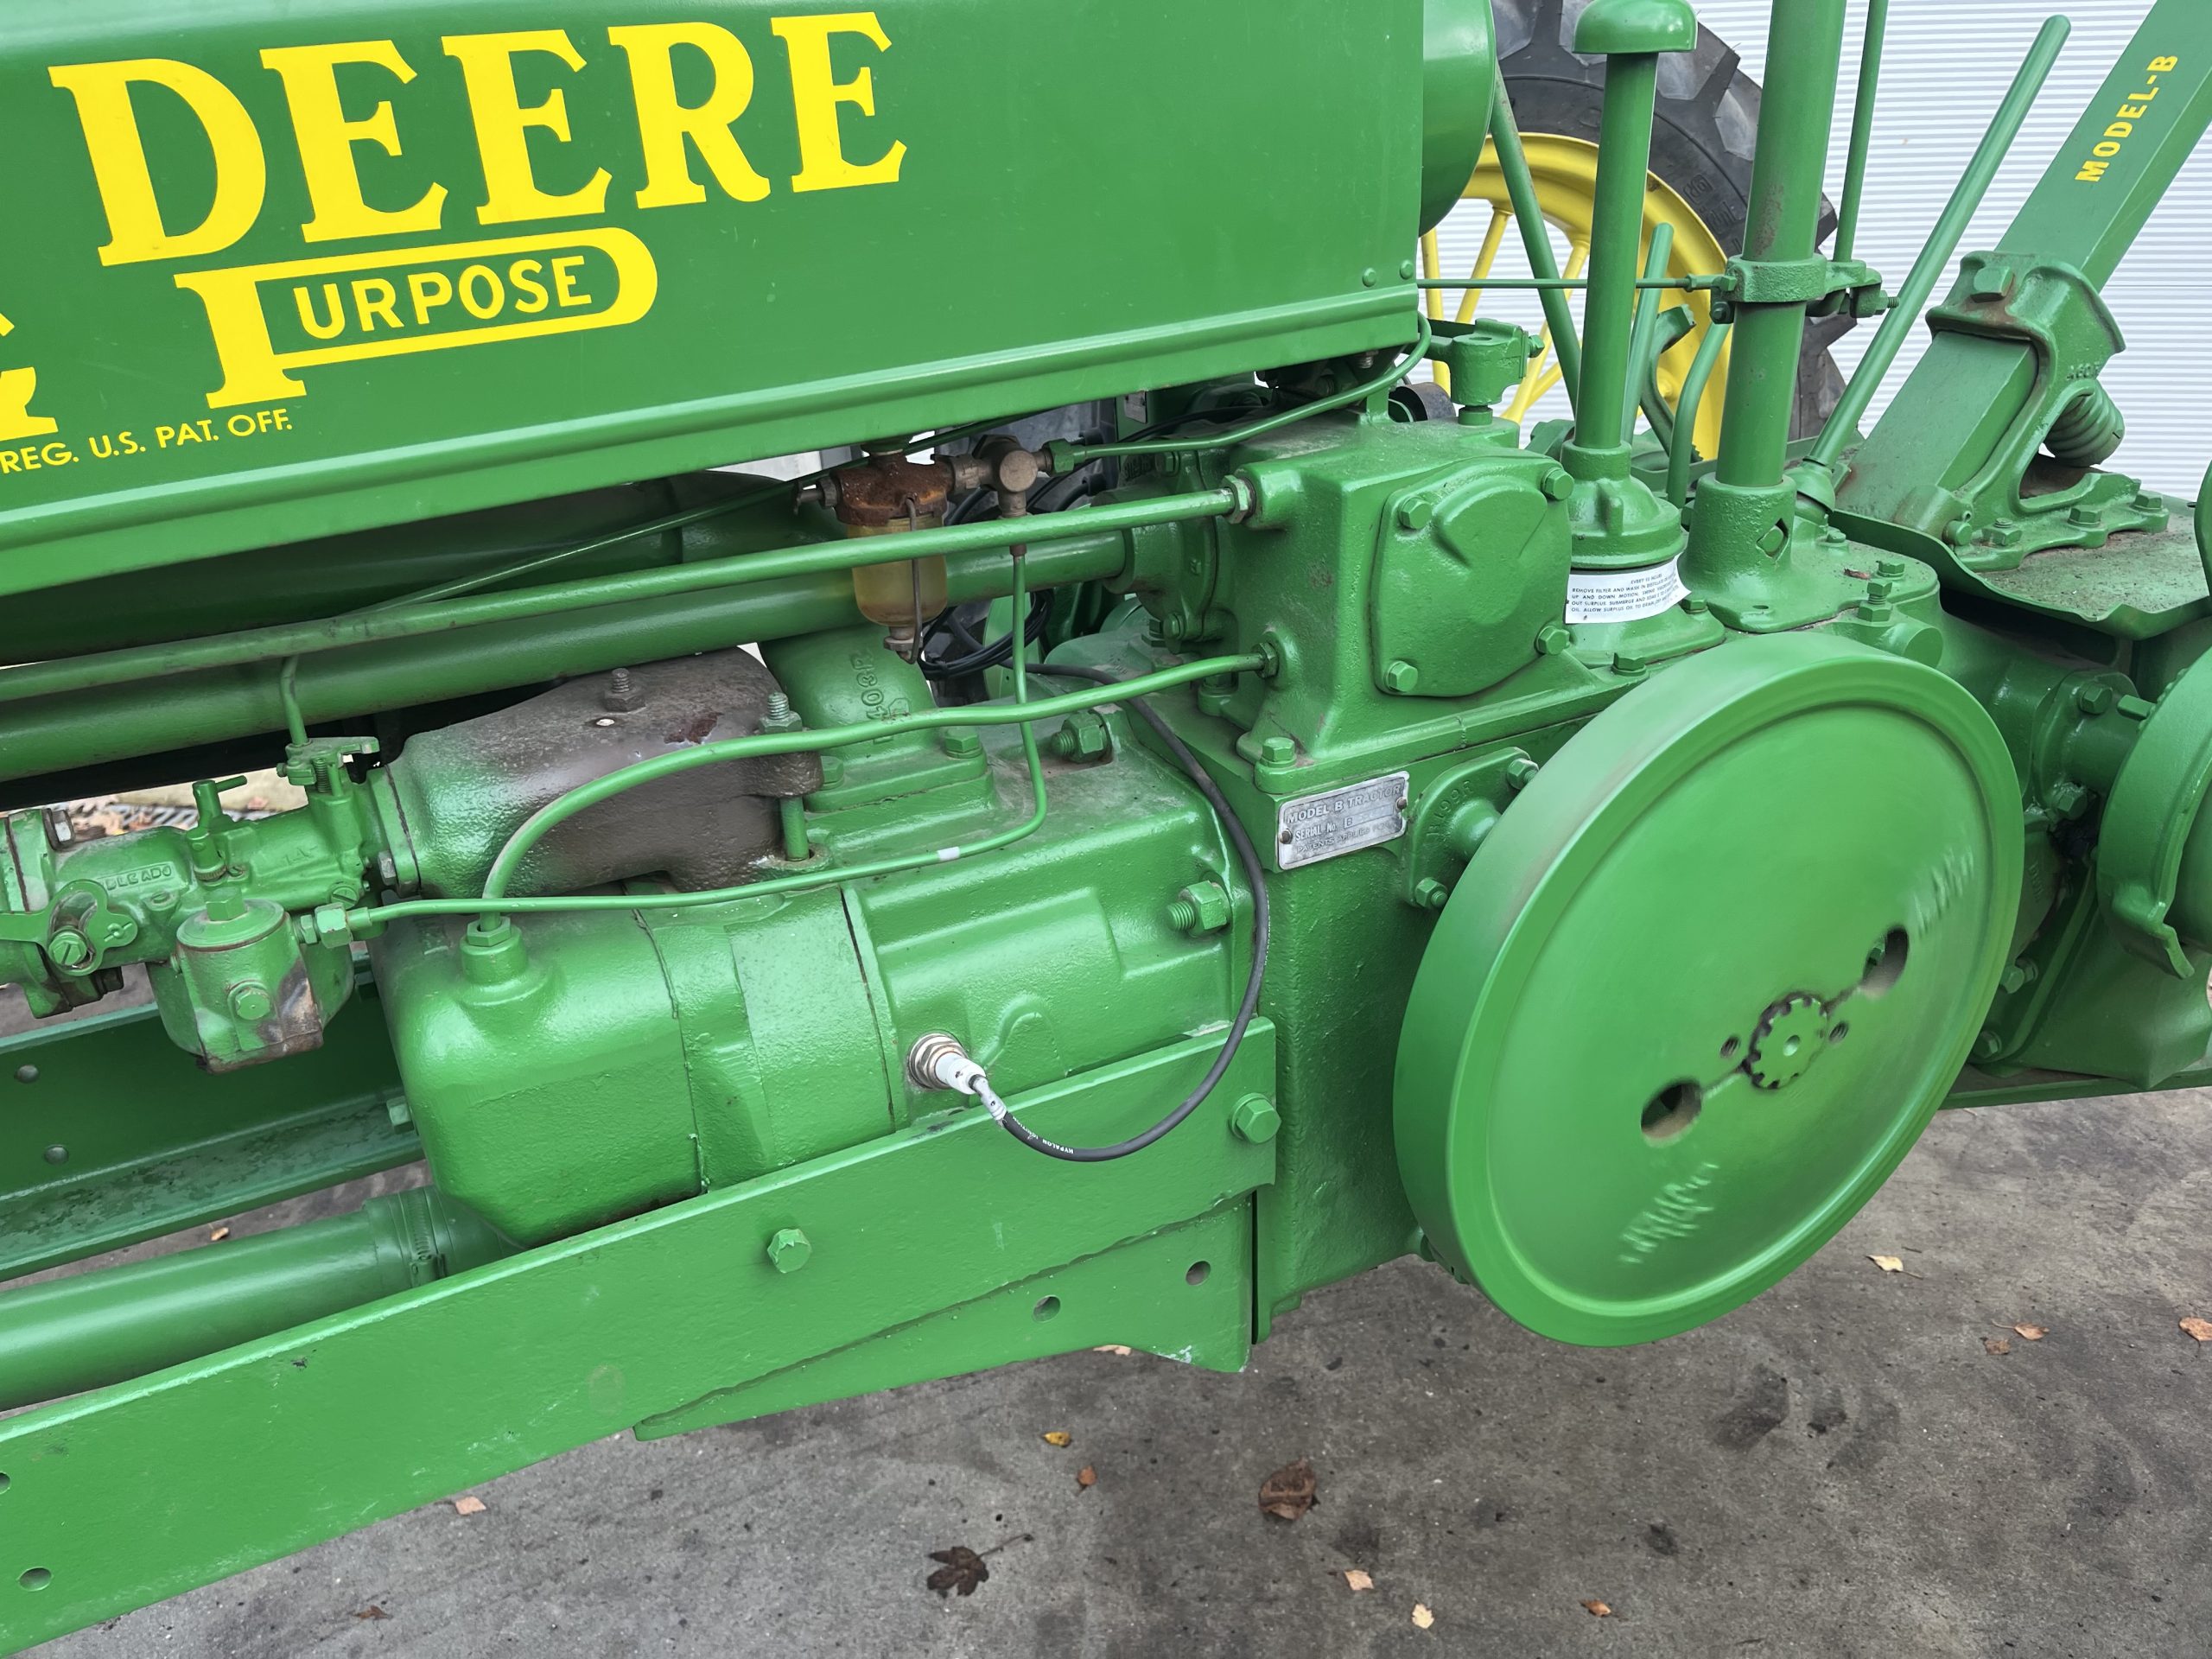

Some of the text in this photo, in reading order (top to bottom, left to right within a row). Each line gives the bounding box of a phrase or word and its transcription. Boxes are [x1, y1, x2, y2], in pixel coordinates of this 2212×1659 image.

[2075, 56, 2178, 182] MODEL-B
[48, 11, 907, 267] DEERE
[0, 408, 293, 474] REG. U.S. PAT. OFF.
[1287, 785, 1400, 824] MODEL B TRACTOR
[1296, 825, 1321, 841] SERIAL
[1298, 838, 1335, 852] PATENTS
[1042, 1138, 1074, 1154] HYPALON
